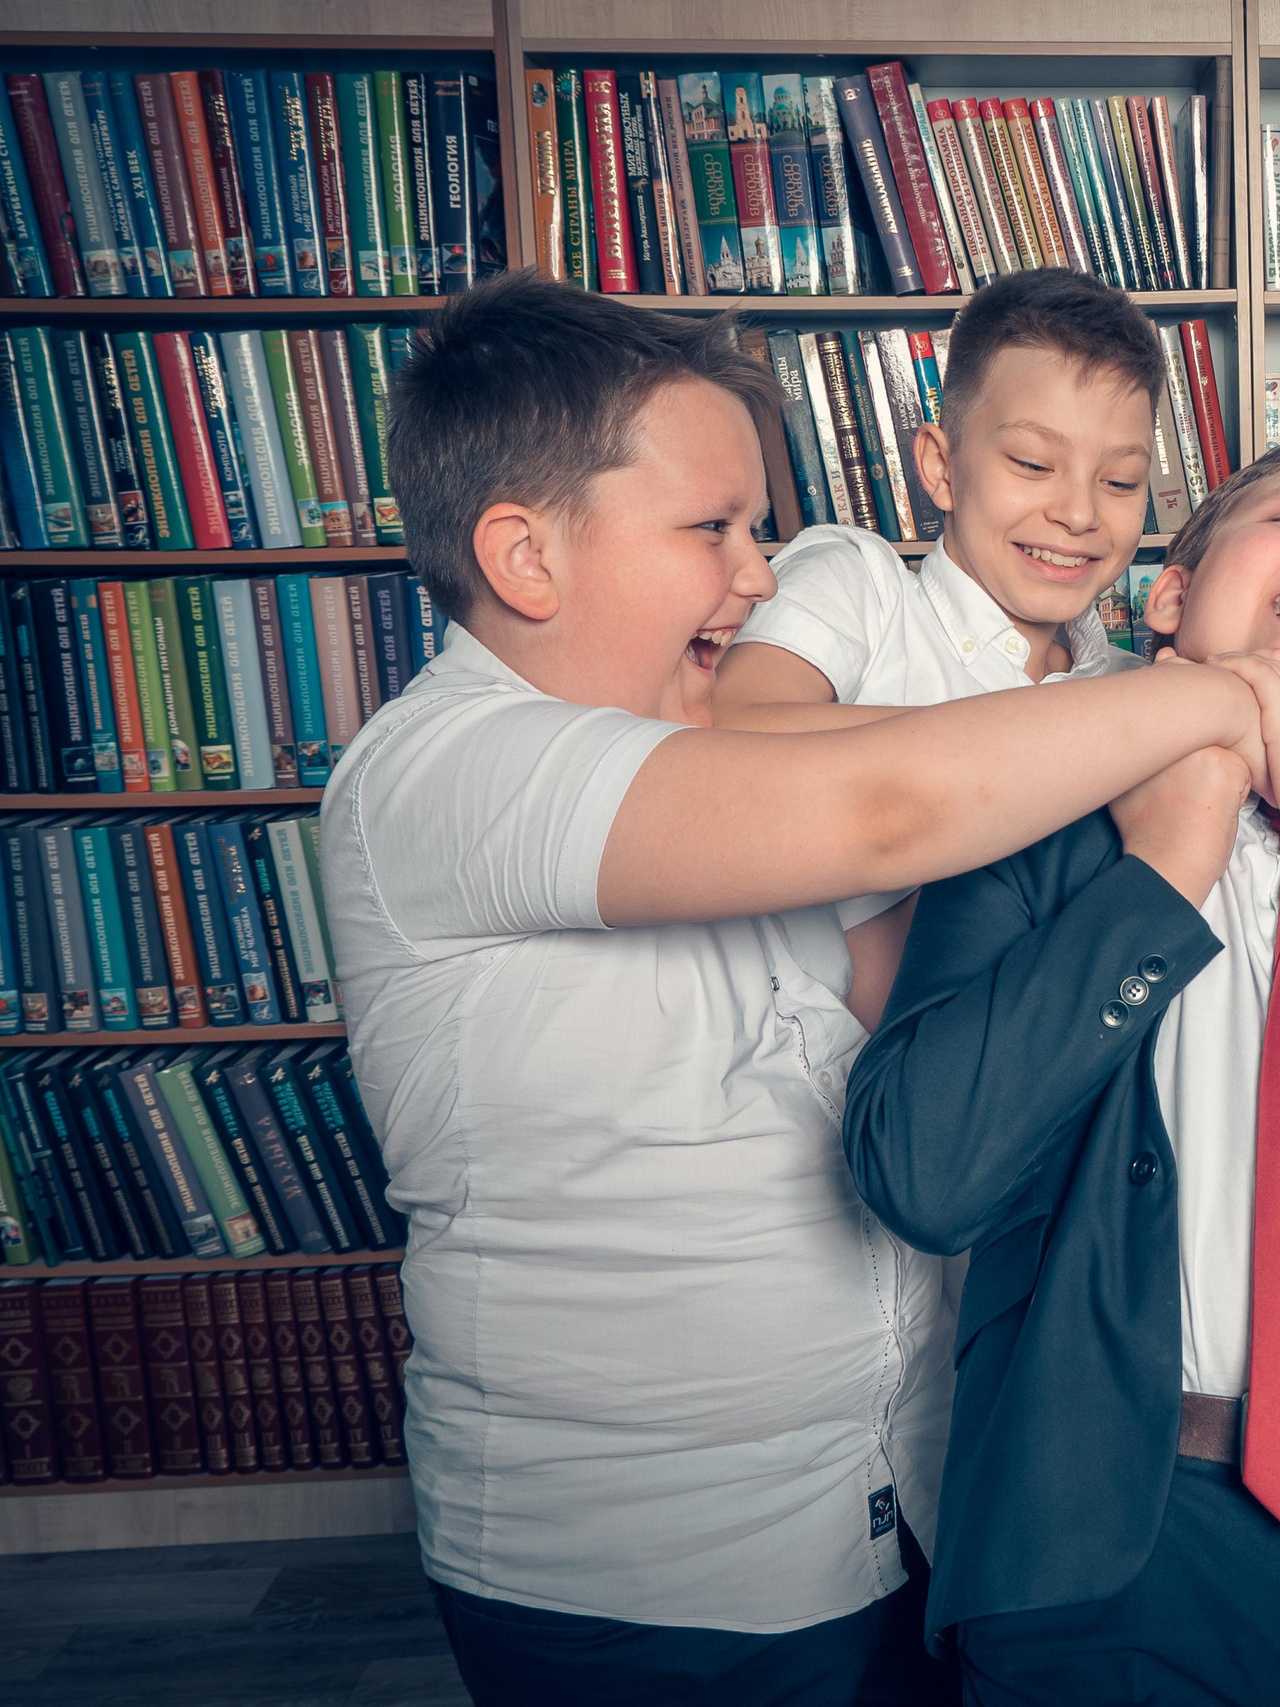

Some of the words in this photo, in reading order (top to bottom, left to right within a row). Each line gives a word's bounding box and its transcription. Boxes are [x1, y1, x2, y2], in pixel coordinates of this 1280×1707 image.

[58, 80, 74, 116] ДЕТЕЙ
[138, 80, 155, 117] ДЕТЕЙ
[241, 77, 257, 113] ДЕТЕЙ
[665, 96, 677, 131] РОССИИ
[66, 121, 80, 144] ДЛЯ
[146, 122, 159, 144] ДЛЯ
[247, 119, 259, 142] ДЛЯ
[619, 92, 635, 152] ЖИВОТНЫХ
[95, 108, 121, 190] САНКТ-ПЕТЕРБУРГ
[126, 149, 142, 173] ВЕК
[563, 139, 576, 180] МИРА
[627, 153, 637, 176] МИР
[937, 127, 961, 192] ПРОГРАММА
[945, 125, 967, 185] РЕШЕНИЯХ
[973, 124, 998, 183] РЕШЕНИЯХ
[987, 127, 1012, 191] ПРОГРАММА
[1023, 123, 1048, 183] РЕШЕНИЯХ
[297, 165, 309, 210] ЧЕЛОВЕКА
[321, 165, 331, 195] РОССИИ
[445, 135, 461, 209] ГЕОЛОГИЯ
[594, 102, 622, 259] ВЕТЕРИНАРИЯ
[674, 151, 684, 191] ЗОЛОТОЙ
[991, 187, 1000, 195] И
[2, 159, 29, 239] ЗАРУБЕЖНЫЕ
[72, 150, 100, 242] ЭНЦИКЛОПЕДИЯ
[151, 150, 177, 243] ЭНЦИКЛОПЕДИЯ
[220, 167, 236, 228] МОСКВОВЕДЕНИЕ
[251, 146, 272, 239] ЭНЦИКЛОПЕДИЯ
[289, 174, 302, 223] ДУХОВНЫЙ
[963, 188, 971, 196] И
[116, 201, 131, 241] МОСКВА
[301, 212, 312, 232] МИР
[324, 197, 335, 232] ИСТОРИЯ
[567, 186, 580, 246] СТРАНЫ
[679, 198, 691, 239] ПЛУТАРХ
[956, 195, 979, 257] ШКОЛЬНАЯ
[994, 196, 1012, 243] ОТВЕТАХ
[1009, 193, 1028, 256] ШКОЛЬНАЯ
[1043, 195, 1060, 242] ОТВЕТАХ
[570, 252, 583, 278] ВСЕ
[686, 242, 697, 281] ДЕТСКИЙ
[17, 337, 33, 372] ДЕТЕЙ
[121, 349, 141, 391] ДЕТЕЙ
[26, 377, 38, 399] ДЛЯ
[790, 369, 803, 401] мира
[132, 397, 147, 424] ДЛЯ
[244, 395, 259, 421] ДЛЯ
[1204, 391, 1219, 450] ПРАВОСЛАВНАЯ
[31, 404, 55, 496] ЭНЦИКЛОПЕДИЯ
[217, 430, 234, 481] КОМПЬЮТЕР
[870, 428, 879, 452] ЮНОГО
[139, 430, 170, 538] ЭНЦИКЛОПЕДИЯ
[251, 427, 281, 535] ЭНЦИКЛОПЕДИЯ
[831, 470, 840, 480] И
[1186, 451, 1206, 495] 1941
[834, 484, 848, 512] КАК
[51, 588, 65, 622] ДЕТЕЙ
[103, 590, 116, 624] ДЕТЕЙ
[187, 586, 202, 620] ДЕТЕЙ
[219, 595, 236, 636] ДЕТЕЙ
[58, 626, 70, 648] ДЛЯ
[109, 629, 121, 650] ДЛЯ
[154, 617, 170, 670] ПИТОМЦЫ
[194, 625, 205, 646] ДЛЯ
[226, 642, 240, 667] ДЛЯ
[61, 653, 82, 741] ЭНЦИКЛОПЕДИЯ
[112, 655, 132, 743] ЭНЦИКЛОПЕДИЯ
[163, 674, 180, 735] ДОМАШНИЕ
[198, 651, 218, 738] ЭНЦИКЛОПЕДИЯ
[230, 672, 255, 777] ЭНЦИКЛОПЕДИЯ
[80, 835, 95, 868] ДЕТЕЙ
[148, 832, 164, 865] ДЕТЕЙ
[88, 872, 99, 894] ДЛЯ
[157, 870, 168, 891] ДЛЯ
[92, 898, 113, 984] ЭНЦИКЛОПЕДИЯ
[162, 895, 185, 980] ЭНЦИКЛОПЕДИЯ
[134, 1074, 155, 1105] ДЕТЕЙ
[150, 1108, 164, 1129] ДЛЯ
[158, 1133, 196, 1213] ЭНЦИКЛОПЕДИЯ
